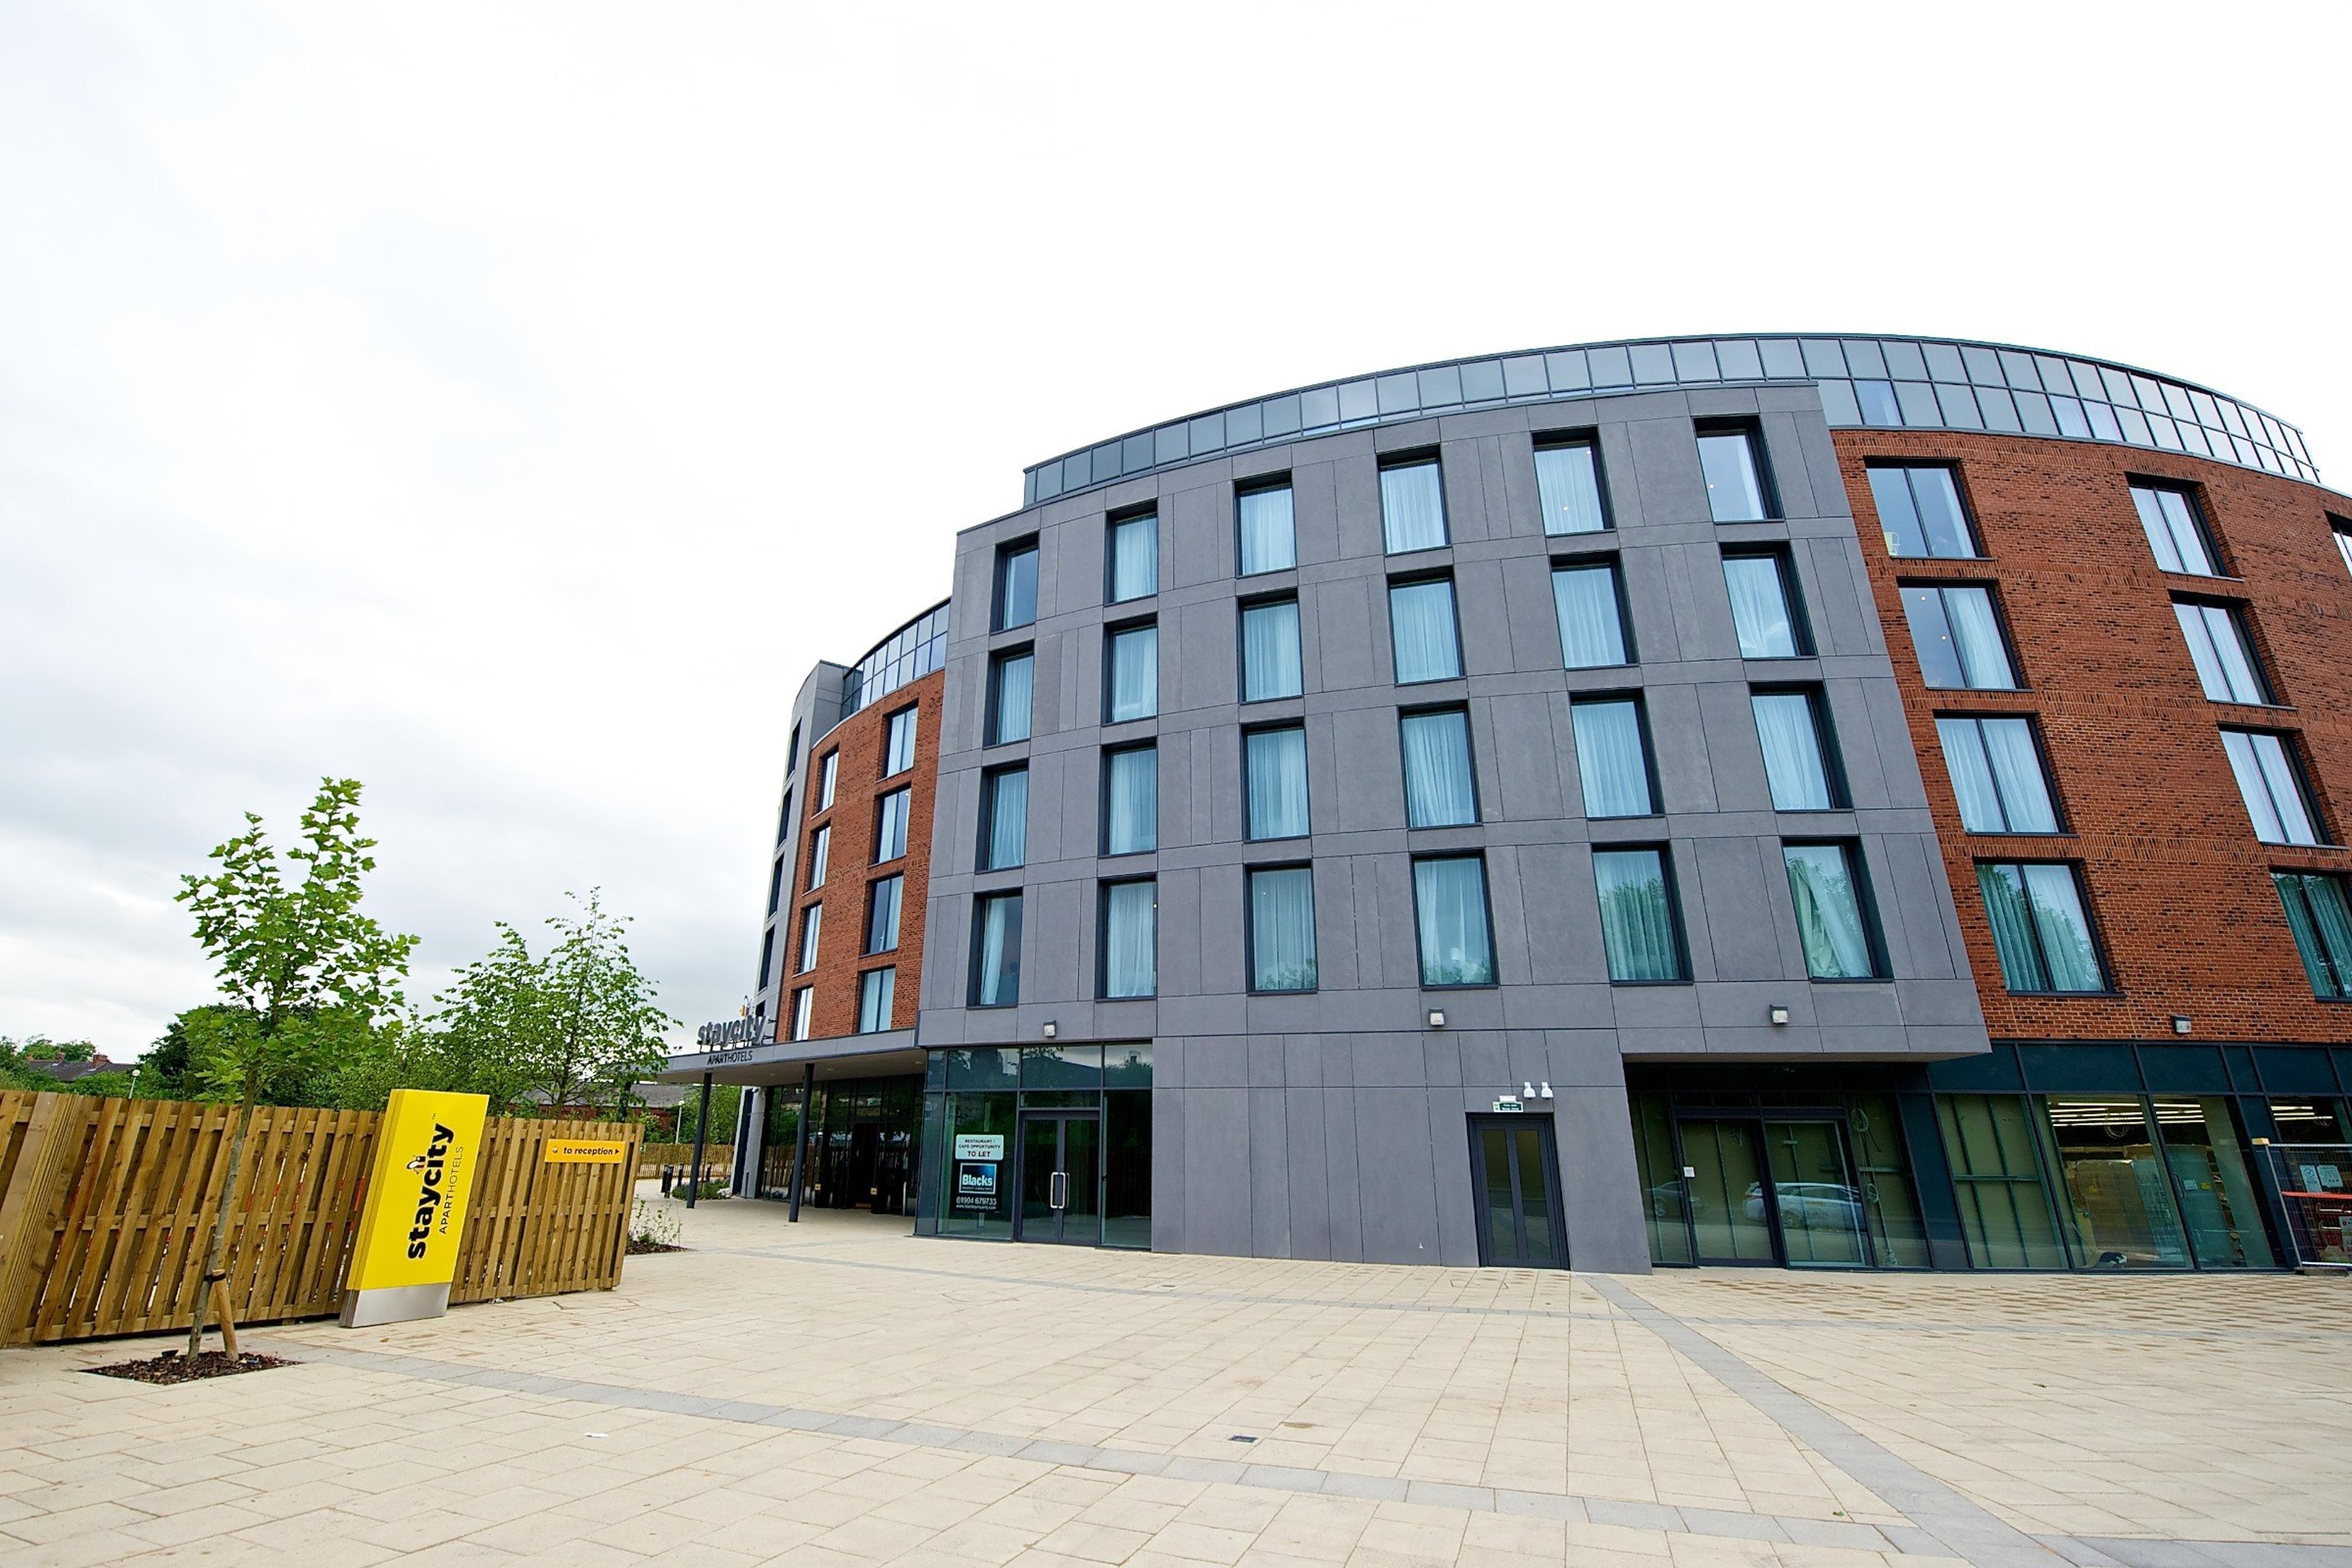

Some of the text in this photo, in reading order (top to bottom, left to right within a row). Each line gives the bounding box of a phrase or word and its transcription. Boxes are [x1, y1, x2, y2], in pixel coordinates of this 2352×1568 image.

[698, 1015, 767, 1048] staycity
[707, 1050, 753, 1065] APARTHOTELS
[575, 1147, 613, 1156] reception
[408, 1123, 454, 1260] staycity
[439, 1146, 464, 1235] APARTHOTELS
[962, 1174, 993, 1186] Blacks
